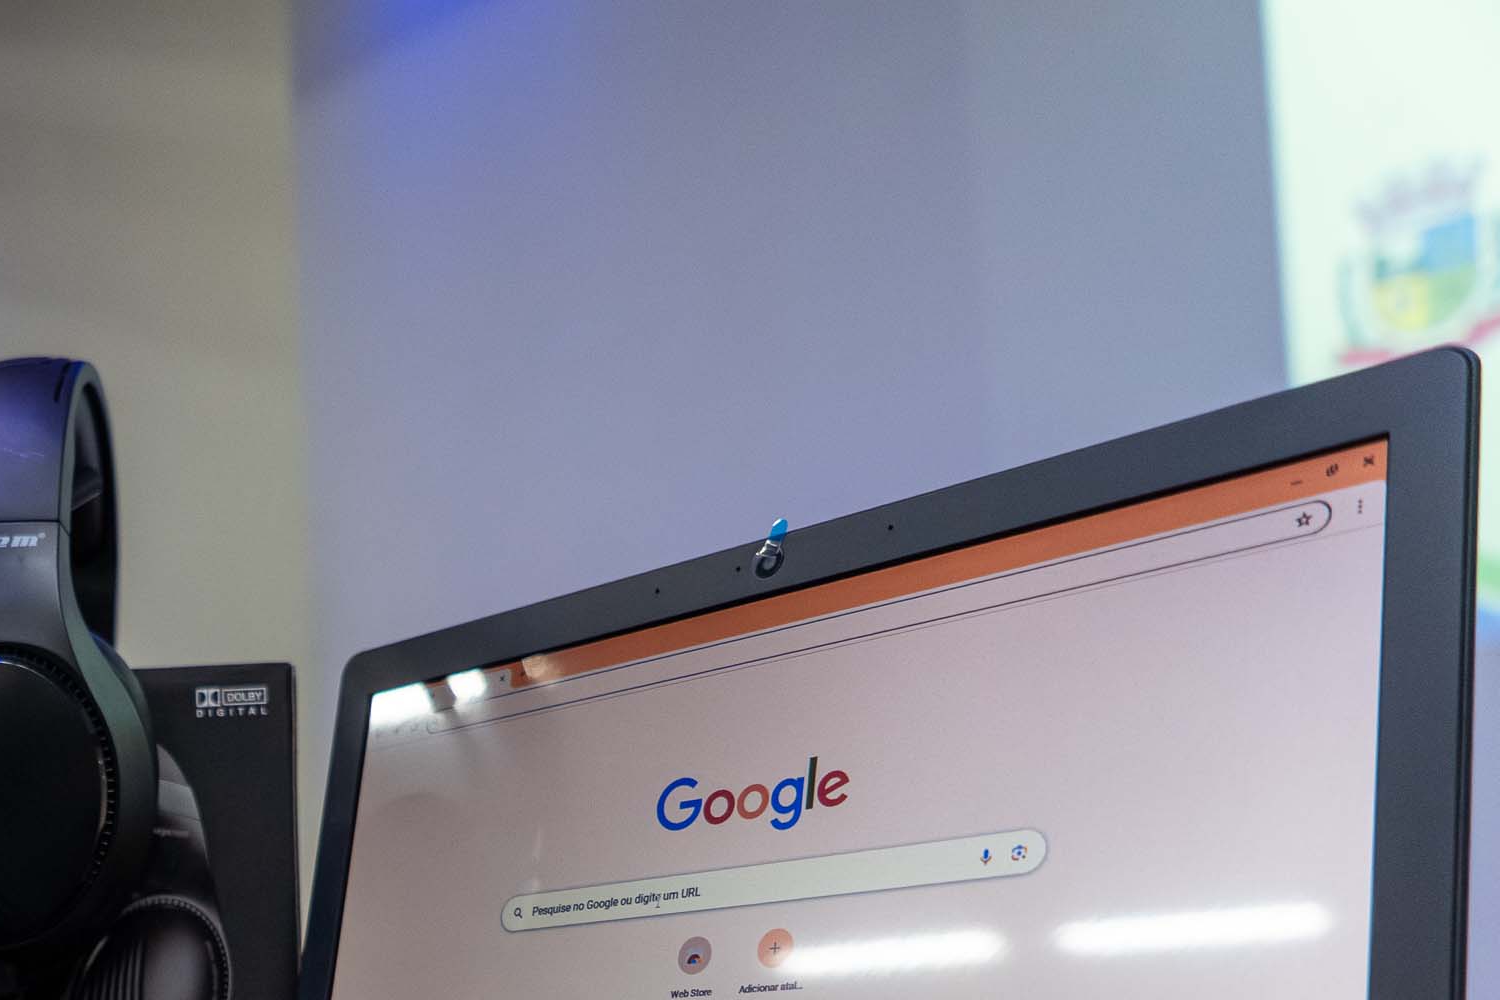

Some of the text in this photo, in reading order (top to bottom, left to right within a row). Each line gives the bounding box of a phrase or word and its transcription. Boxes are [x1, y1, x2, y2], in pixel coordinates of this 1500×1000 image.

[226, 691, 262, 702] DOLBY
[196, 706, 268, 718] DIGITAL
[657, 756, 850, 831] Google
[532, 887, 701, 918] Pesquise no Google ou digite um URL
[671, 988, 713, 998] Web Store
[738, 983, 779, 994] Adicionar
